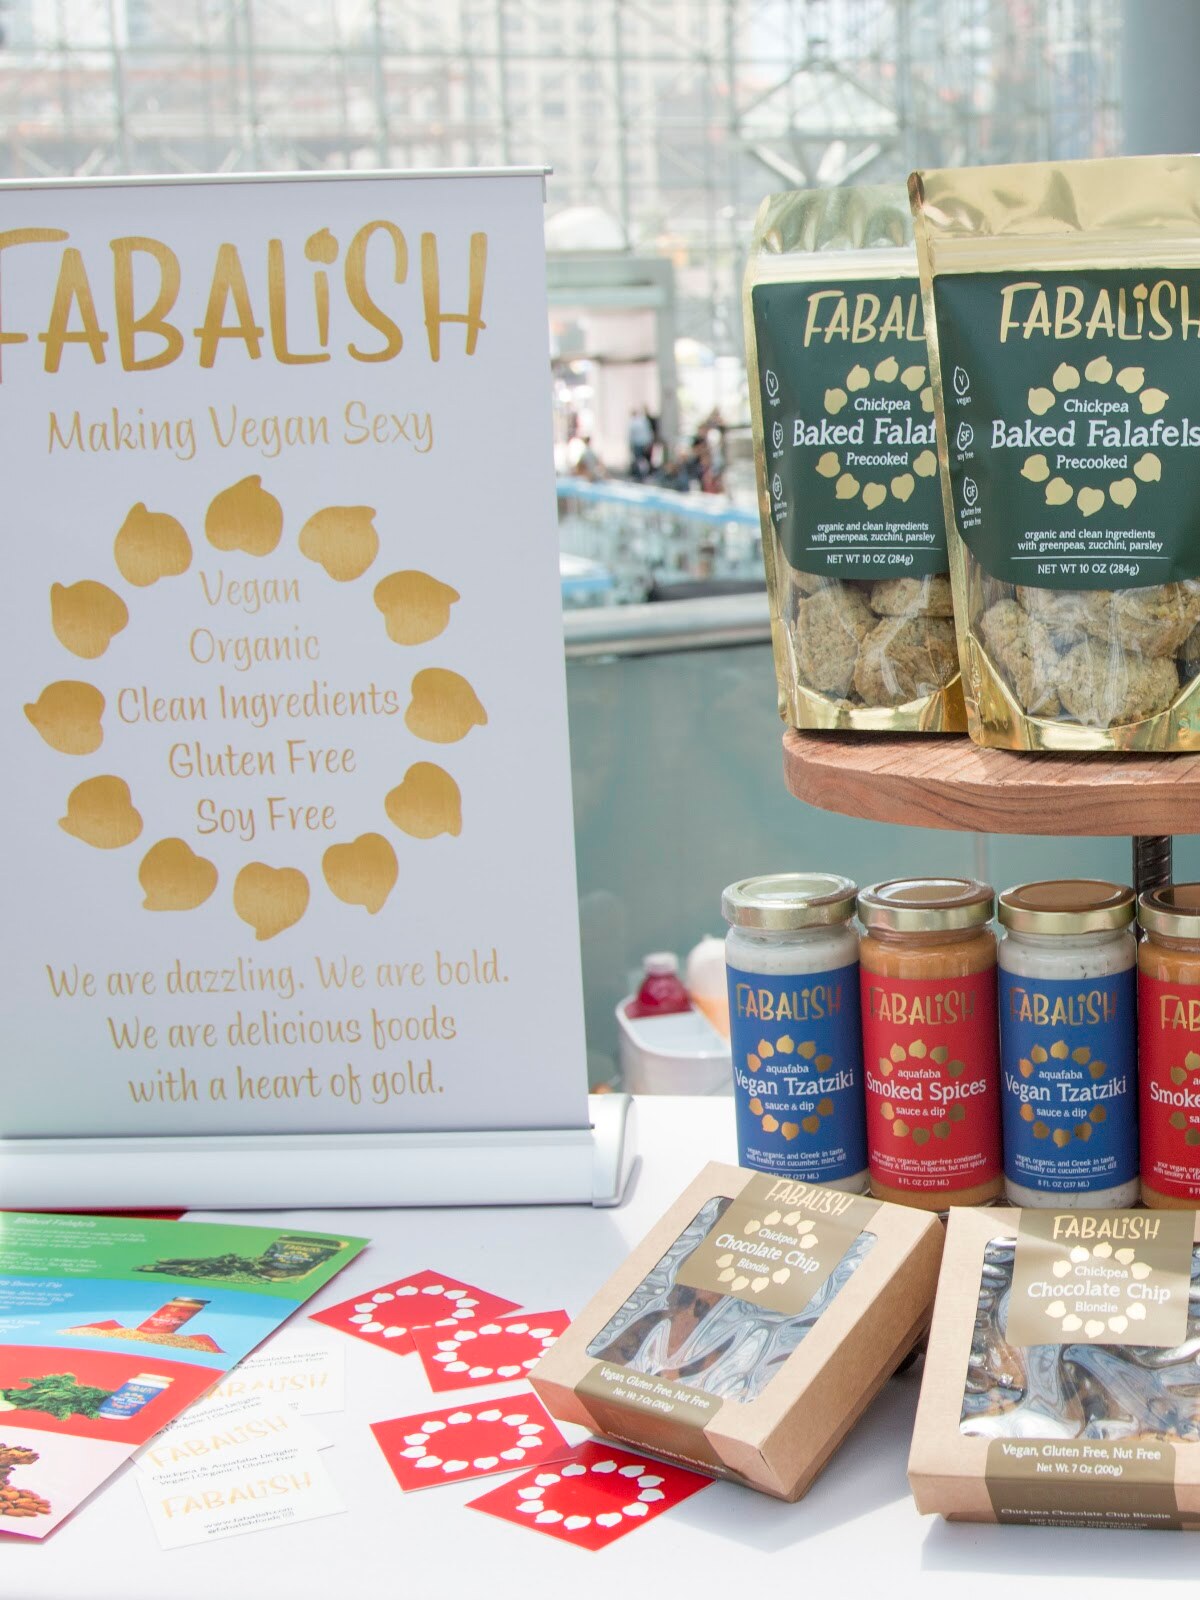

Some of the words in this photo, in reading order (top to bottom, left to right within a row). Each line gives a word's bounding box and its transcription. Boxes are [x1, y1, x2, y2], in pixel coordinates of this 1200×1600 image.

[854, 397, 911, 413] Chickpea
[1063, 399, 1129, 416] Chickpea
[48, 407, 197, 460] Making
[208, 404, 329, 458] Vegan
[344, 401, 434, 453] Sexy
[792, 418, 865, 448] Baked
[990, 419, 1076, 449] Baked
[845, 451, 909, 467] Precooked
[1055, 454, 1128, 470] Precooked
[1024, 530, 1057, 542] organic
[1060, 529, 1077, 539] and
[1079, 529, 1101, 539] clean
[1103, 528, 1155, 541] ingredients
[1037, 564, 1059, 575] NET
[1061, 564, 1077, 574] WT
[1079, 563, 1090, 574] 10
[1091, 563, 1107, 574] OZ
[1109, 563, 1140, 576] (284g)
[199, 570, 301, 613] Vegan
[189, 625, 320, 671] Organic
[117, 686, 207, 724] Clean
[219, 680, 400, 727] Ingredients
[168, 742, 276, 778] Gluten
[286, 740, 357, 775] Free
[196, 798, 256, 841] Soy
[267, 797, 337, 830] Free
[46, 964, 97, 998] We
[107, 969, 156, 995] are
[167, 958, 304, 999] dazzling.
[315, 955, 365, 989] We
[377, 961, 425, 988] are
[436, 948, 510, 986] bold.
[107, 1016, 158, 1050] We
[168, 1021, 218, 1047] are
[228, 1010, 361, 1046] delicious
[372, 1004, 457, 1049] foods
[766, 1064, 809, 1074] aquafaba
[897, 1069, 940, 1080] aquafaba
[1039, 1070, 1083, 1081] aquafaba
[129, 1068, 199, 1103] with
[210, 1078, 228, 1101] a
[238, 1064, 320, 1099] heart
[330, 1064, 362, 1105] of
[372, 1060, 444, 1103] gold.
[734, 1066, 778, 1097] Vegan
[783, 1069, 854, 1096] Tzatziki
[866, 1071, 921, 1101] Smoked
[929, 1077, 987, 1104] Spices
[1004, 1071, 1051, 1103] Vegan
[1056, 1075, 1127, 1102] Tzatziki
[1036, 1108, 1062, 1118] sauce
[1063, 1108, 1071, 1118] &
[1071, 1107, 1087, 1120] dip
[758, 1228, 798, 1248] Chickpea
[715, 1233, 782, 1262] Chocolate
[784, 1249, 820, 1275] Chip
[736, 1256, 770, 1275] Blondie
[1074, 1265, 1128, 1280] Chickpea
[1027, 1281, 1120, 1298] Chocolate
[1127, 1283, 1171, 1304] Chip
[1075, 1301, 1118, 1313] Blondie
[1002, 1444, 1040, 1460] Vegan,
[1042, 1445, 1080, 1460] Gluten
[1082, 1447, 1110, 1460] Free,
[1112, 1448, 1135, 1460] Nut
[1136, 1449, 1161, 1461] Free
[1036, 1463, 1052, 1474] Net
[1079, 1464, 1092, 1475] Oz
[1094, 1464, 1123, 1476] (200g)
